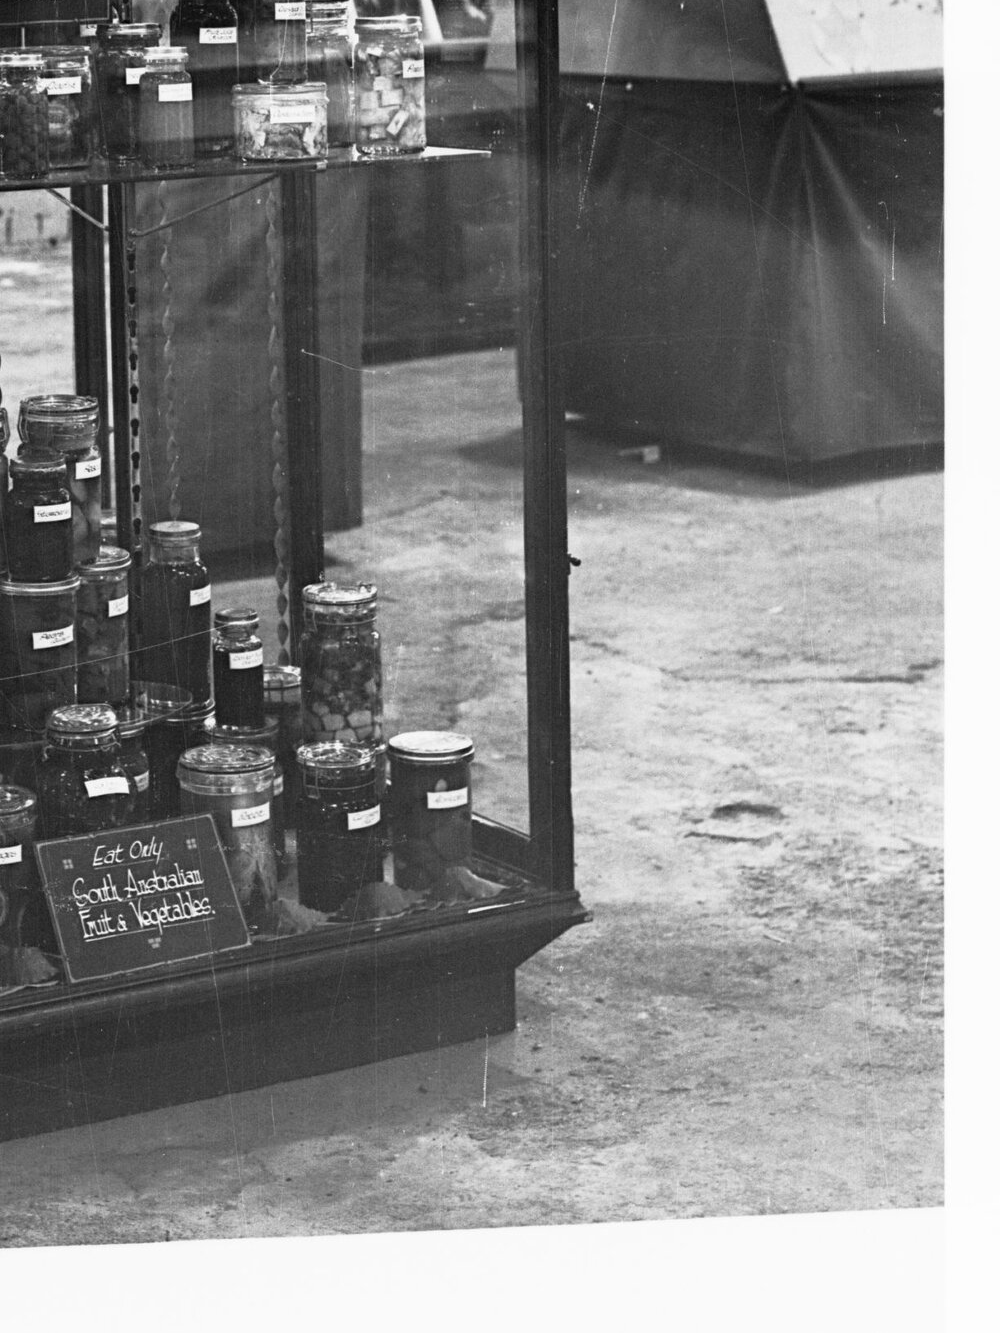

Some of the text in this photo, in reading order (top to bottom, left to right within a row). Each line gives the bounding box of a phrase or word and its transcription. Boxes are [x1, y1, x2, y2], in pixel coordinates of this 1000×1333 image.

[92, 836, 163, 867] Eat Only
[72, 862, 205, 907] South Australian
[78, 891, 216, 940] Fruit & Vegetables.
